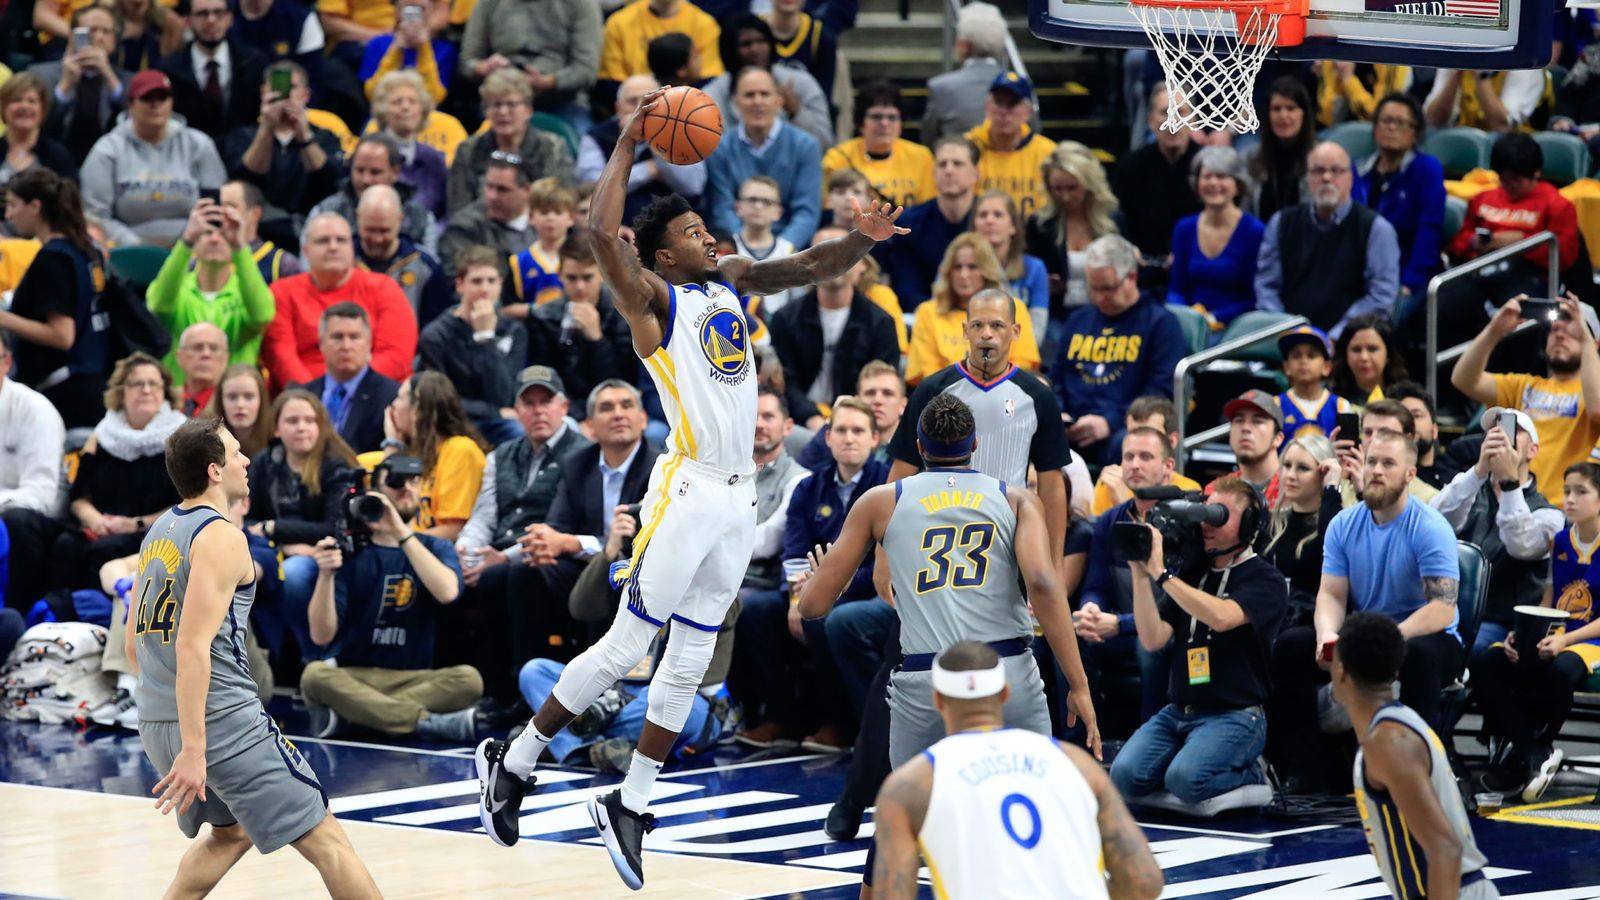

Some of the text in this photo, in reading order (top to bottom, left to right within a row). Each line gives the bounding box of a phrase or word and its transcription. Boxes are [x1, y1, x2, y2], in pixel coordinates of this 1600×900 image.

[1394, 1, 1448, 17] FIELD
[693, 301, 722, 329] GOLDE
[731, 321, 740, 340] 2
[1067, 333, 1142, 363] PACERS
[915, 521, 997, 595] 33
[135, 577, 176, 647] 44
[957, 752, 1049, 786] COUSINS
[1000, 792, 1042, 850] 0
